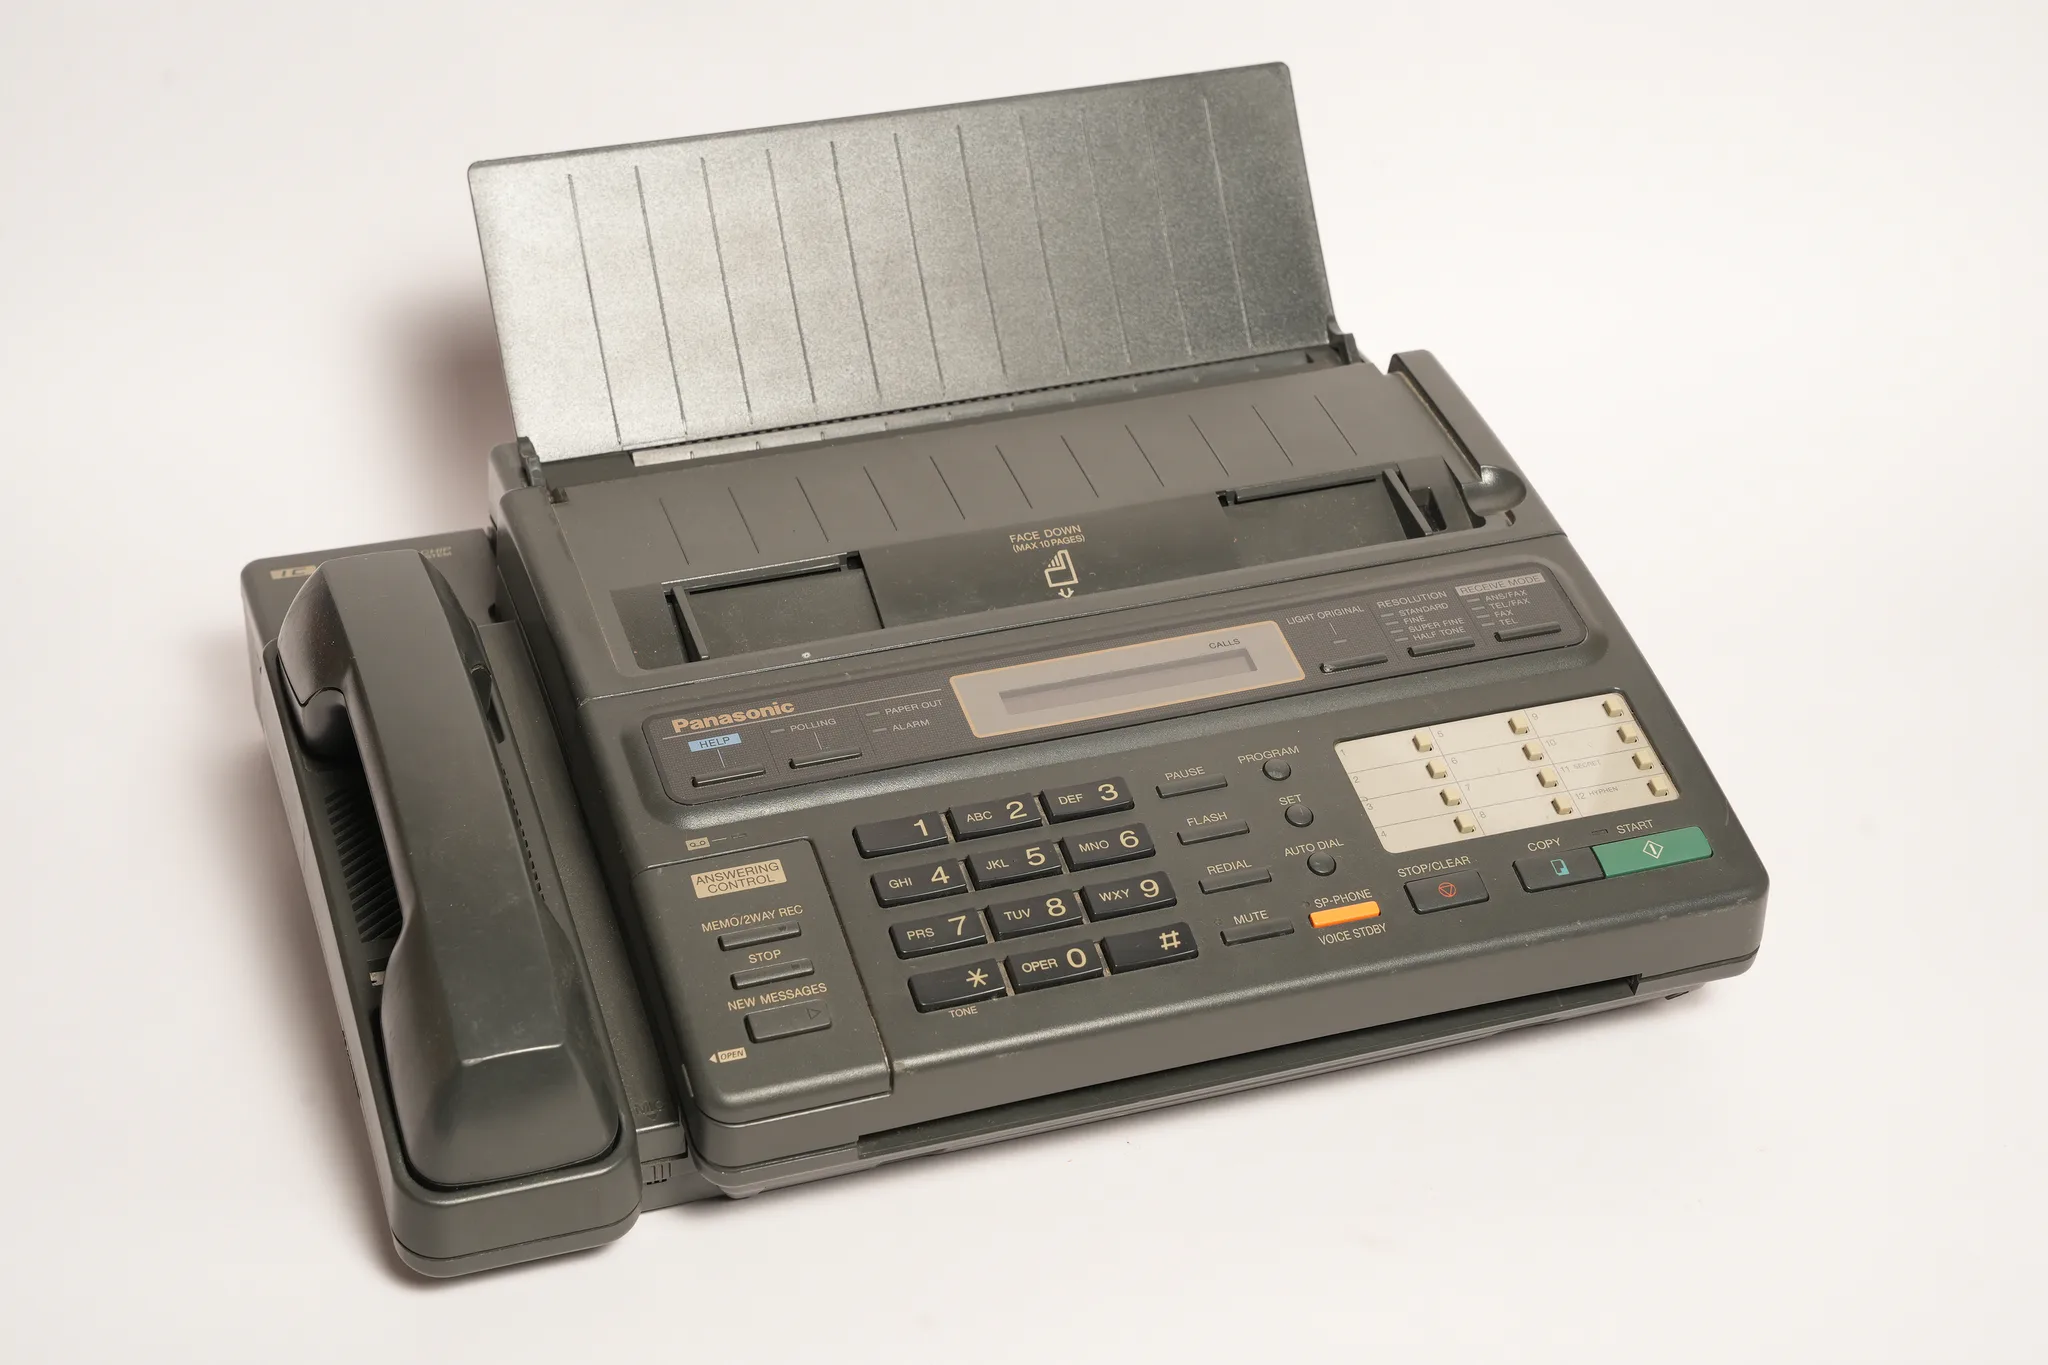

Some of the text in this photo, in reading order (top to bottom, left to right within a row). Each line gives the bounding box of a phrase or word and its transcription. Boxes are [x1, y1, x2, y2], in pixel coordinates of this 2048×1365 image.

[1009, 525, 1081, 543] FACE DOWN
[1012, 534, 1086, 553] (MAX 10 PAGES)
[1460, 576, 1541, 595] RECEIVE MODE
[1377, 590, 1448, 609] RESOLUTION
[1485, 590, 1528, 602] ANS/FAX
[1398, 602, 1449, 618] STANDARD
[1489, 598, 1531, 610] TEL/FAX
[1286, 605, 1365, 626] LIGHT ORIGINAL
[1403, 615, 1426, 625] FINE
[1494, 609, 1514, 618] FAX
[1408, 617, 1465, 633] SUPER FINE
[1499, 619, 1519, 627] TEL
[1412, 626, 1466, 641] HALF TONE
[1208, 638, 1241, 650] CALLS
[884, 699, 943, 716] PAPER OUT
[671, 701, 795, 733] Panasonic
[1531, 713, 1539, 721] 9
[790, 718, 837, 733] POLLING
[892, 719, 930, 732] ALARM
[1437, 730, 1444, 738] 5
[699, 736, 731, 749] HELP
[1545, 739, 1557, 747] 10
[1237, 745, 1300, 764] PROGRAM
[1340, 748, 1347, 756] 1
[1451, 757, 1459, 765] 6
[1164, 766, 1206, 781] PAUSE
[1560, 765, 1571, 773] 11
[1353, 776, 1361, 784] 2
[1098, 783, 1118, 801] 3
[1464, 784, 1472, 792] 7
[1575, 786, 1619, 800] 12 HYPHEN
[1058, 793, 1084, 805] DEF
[1278, 794, 1302, 806] SET
[1005, 800, 1027, 819] 2
[1366, 803, 1374, 811] 3
[966, 810, 993, 823] ABC
[1186, 811, 1228, 827] FLASH
[1479, 811, 1487, 819] 8
[913, 819, 929, 836] 1
[1381, 830, 1388, 838] 4
[1616, 819, 1654, 834] START
[1078, 839, 1110, 852] MNO
[1119, 829, 1139, 848] 6
[1527, 837, 1562, 852] COPY
[1284, 837, 1344, 857] AUTO DIAL
[986, 858, 1010, 870] JKL
[1025, 847, 1046, 866] 5
[696, 861, 780, 886] ANSWERING
[1206, 859, 1252, 875] REDIAL
[1397, 855, 1471, 878] STOP/CLEAR
[930, 865, 950, 884] 4
[707, 874, 775, 894] CONTROL
[888, 876, 913, 889] GHI
[1139, 879, 1160, 898] 9
[1099, 887, 1130, 902] WXY
[1314, 888, 1373, 909] SP-PHONE
[1004, 907, 1031, 921] TUV
[1045, 897, 1067, 917] 8
[701, 904, 804, 933] MEMO/2WAY REC
[1233, 909, 1270, 925] MUTE
[947, 915, 967, 936] 7
[906, 927, 935, 940] PRS
[1318, 922, 1387, 946] VOICE STDBY
[748, 949, 782, 964] STOP
[1066, 947, 1087, 969] 0
[1021, 957, 1058, 974] OPER
[727, 982, 828, 1012] NEW MESSAGES
[949, 1005, 978, 1019] TONE
[720, 1050, 744, 1061] OPEN
